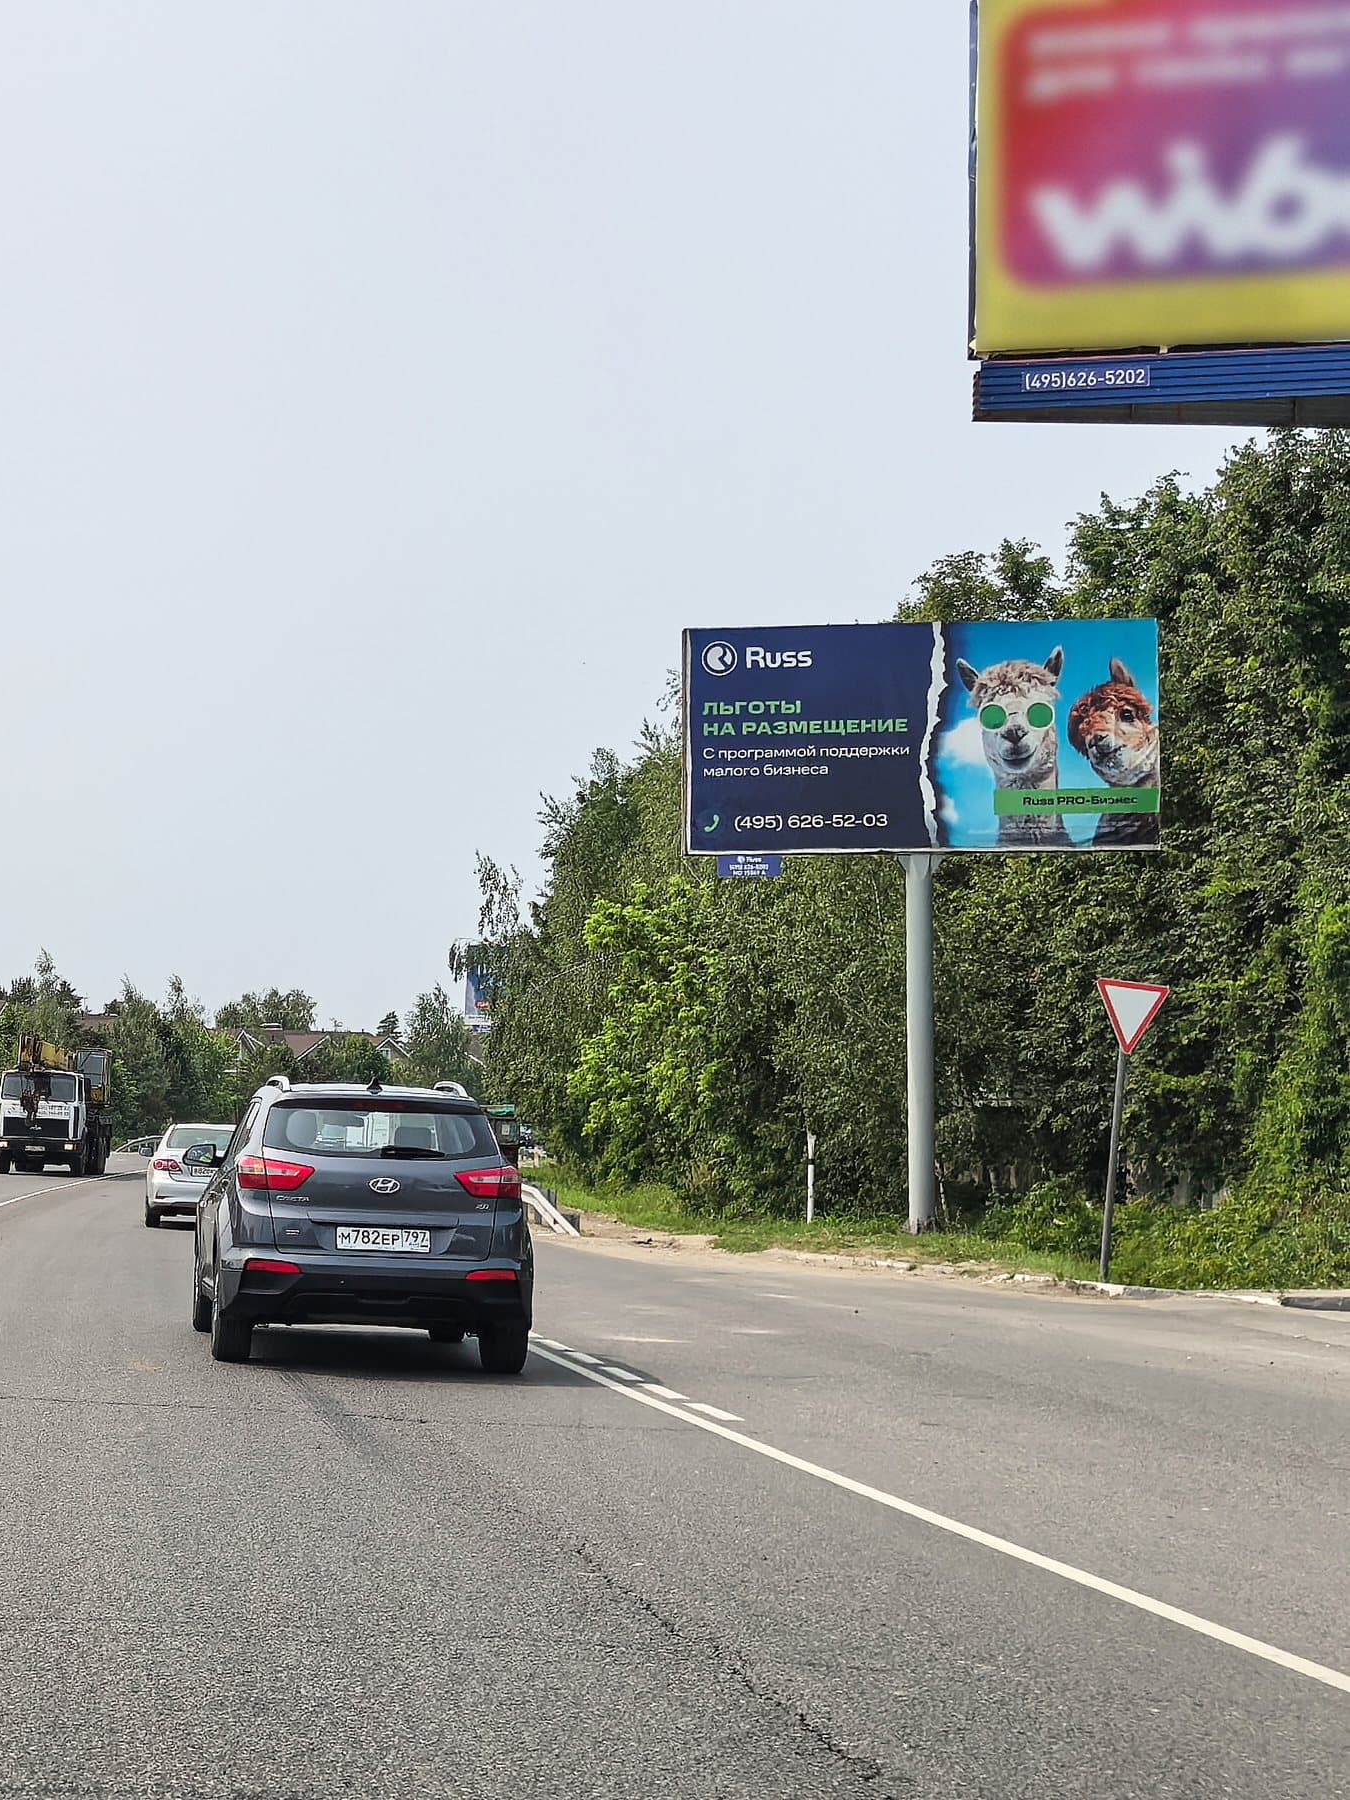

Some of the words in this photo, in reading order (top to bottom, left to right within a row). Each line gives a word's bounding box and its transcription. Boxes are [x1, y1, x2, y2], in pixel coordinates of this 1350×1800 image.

[1025, 369, 1145, 390] (495)626-5202
[745, 646, 813, 669] Russ
[702, 700, 802, 717] ЛЬГОТЫ
[703, 721, 736, 737] НА
[742, 718, 909, 737] РАЗМЕЩЕНИЕ
[703, 747, 715, 759] С
[718, 745, 816, 762] программой
[819, 745, 910, 760] поддержки
[703, 766, 760, 778] малого
[763, 763, 829, 777] бизнеса
[734, 814, 783, 832] (495)
[787, 813, 888, 829] 626-52-03
